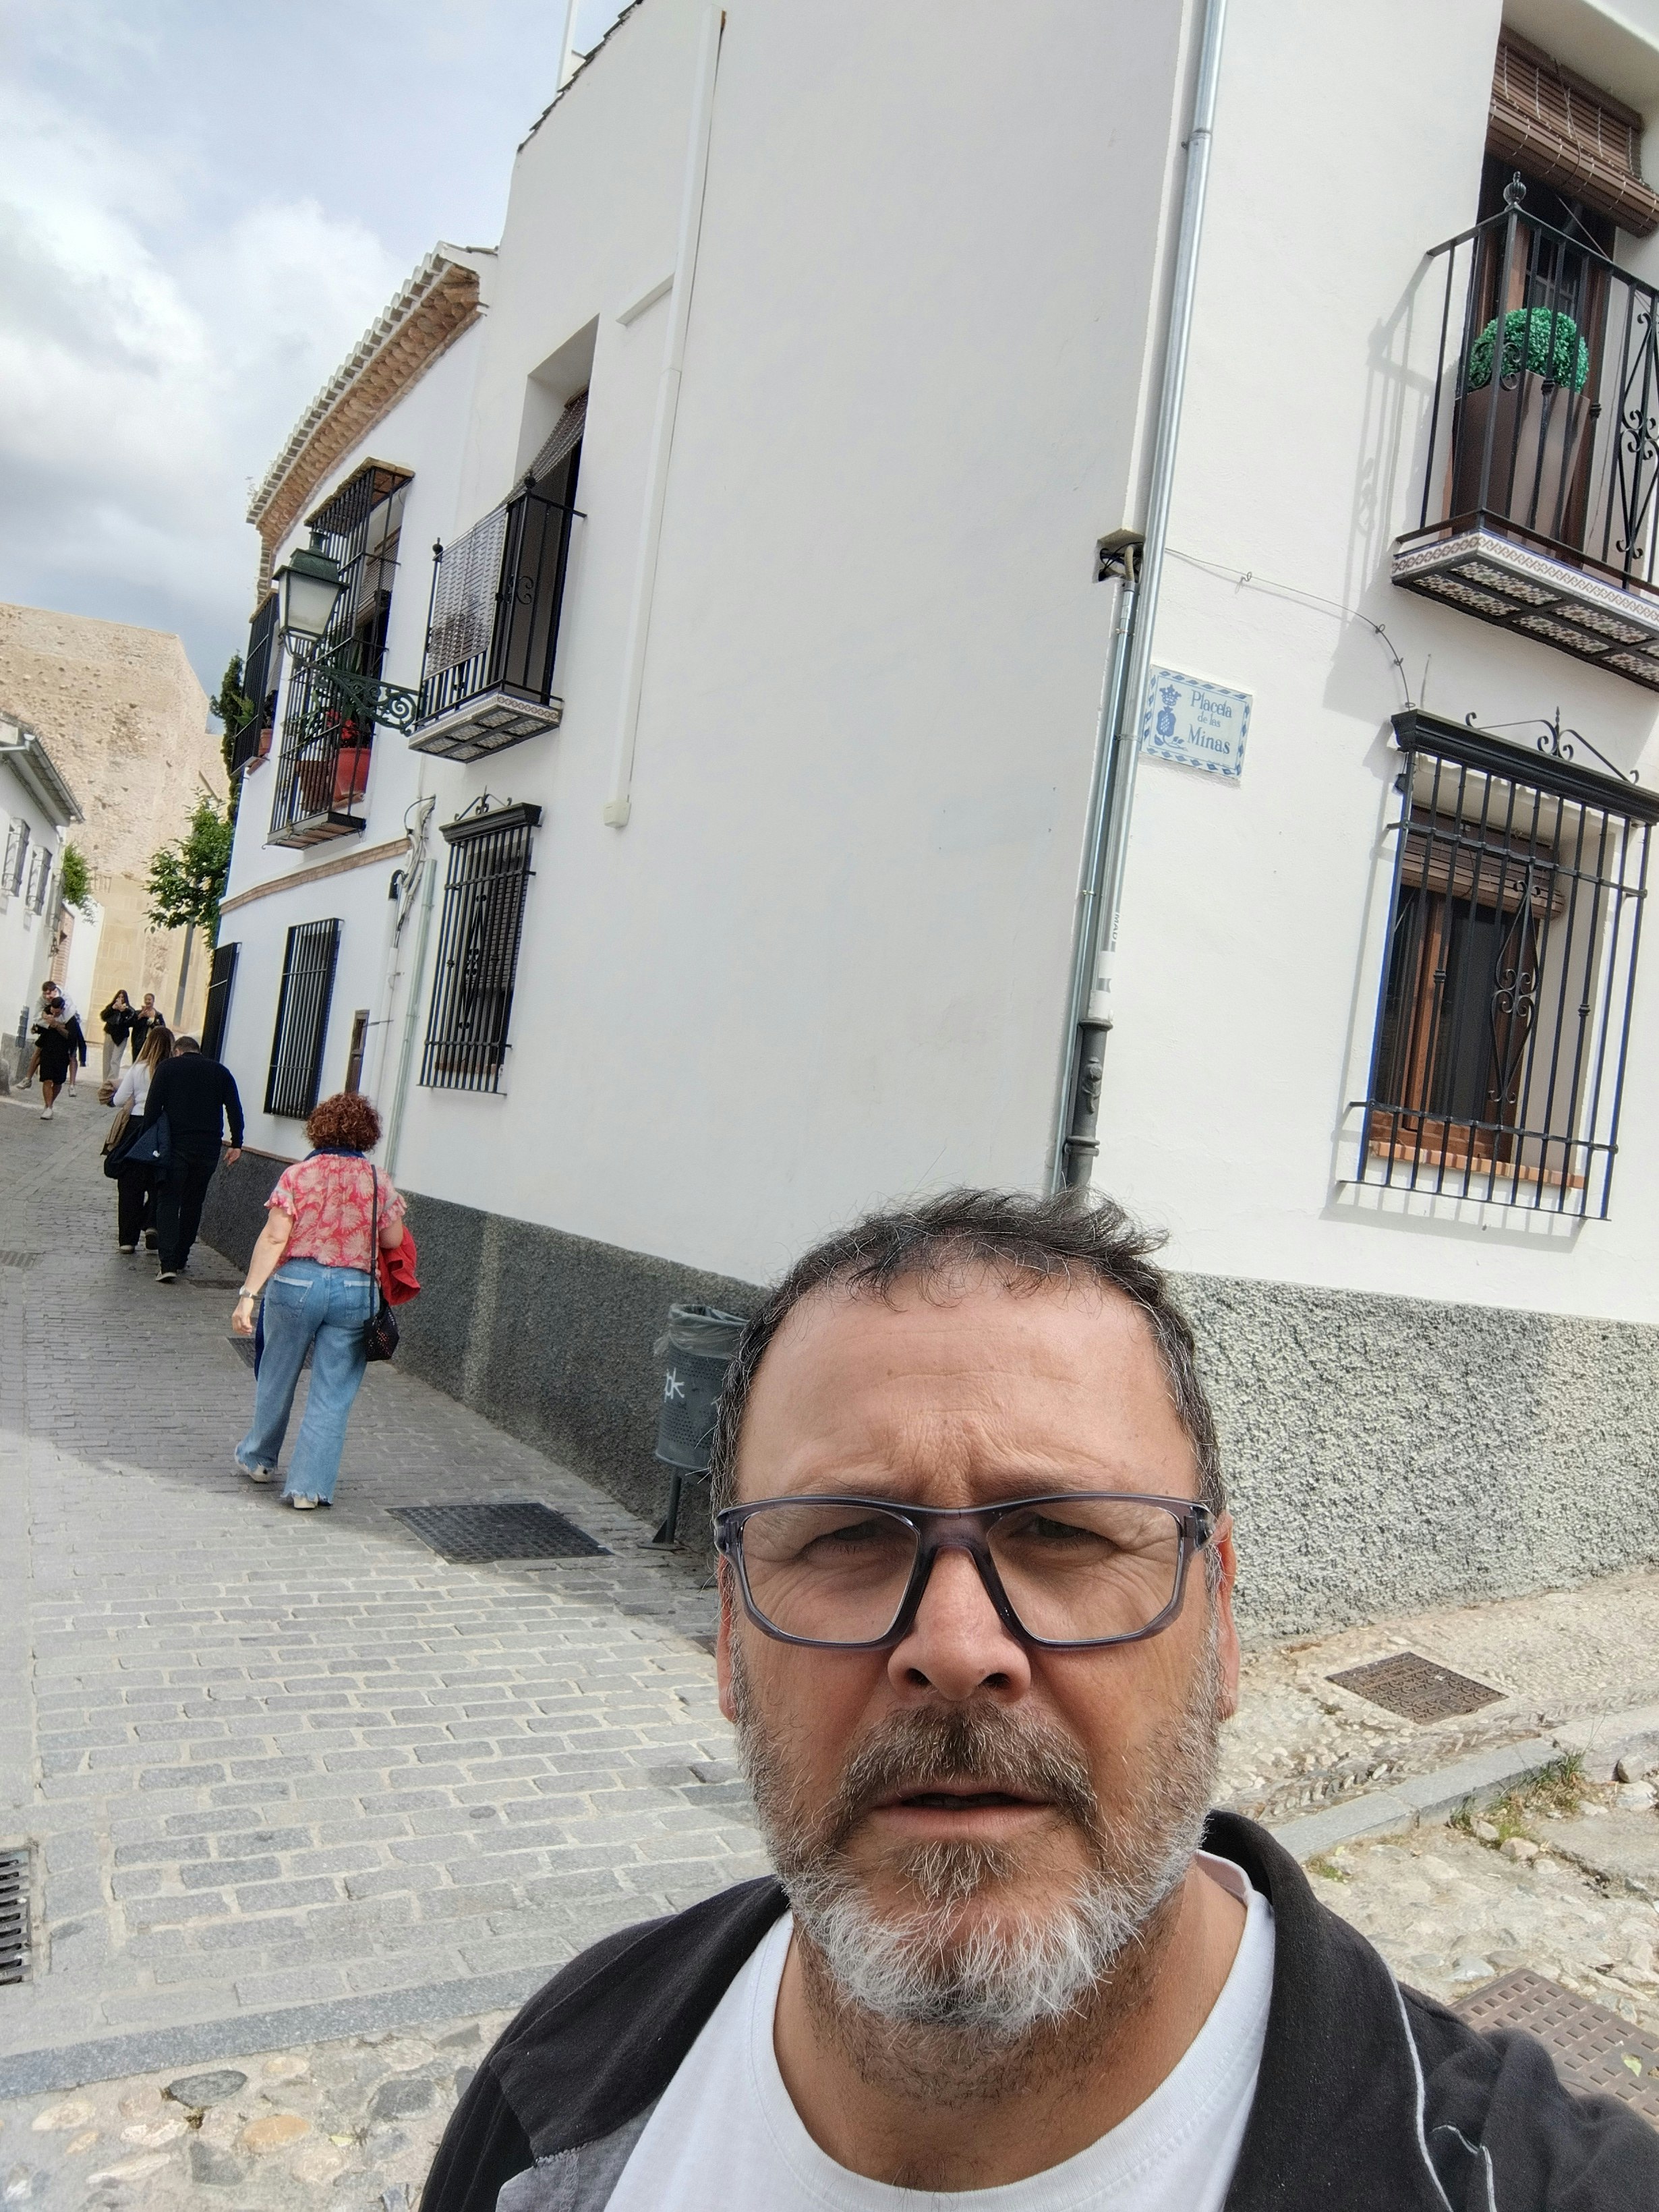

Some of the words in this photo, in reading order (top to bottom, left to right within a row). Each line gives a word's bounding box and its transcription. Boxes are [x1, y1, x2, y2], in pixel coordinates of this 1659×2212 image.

[1190, 689, 1232, 718] Placeta
[1197, 711, 1208, 724] de
[1209, 712, 1221, 728] las
[1188, 724, 1230, 754] Minas
